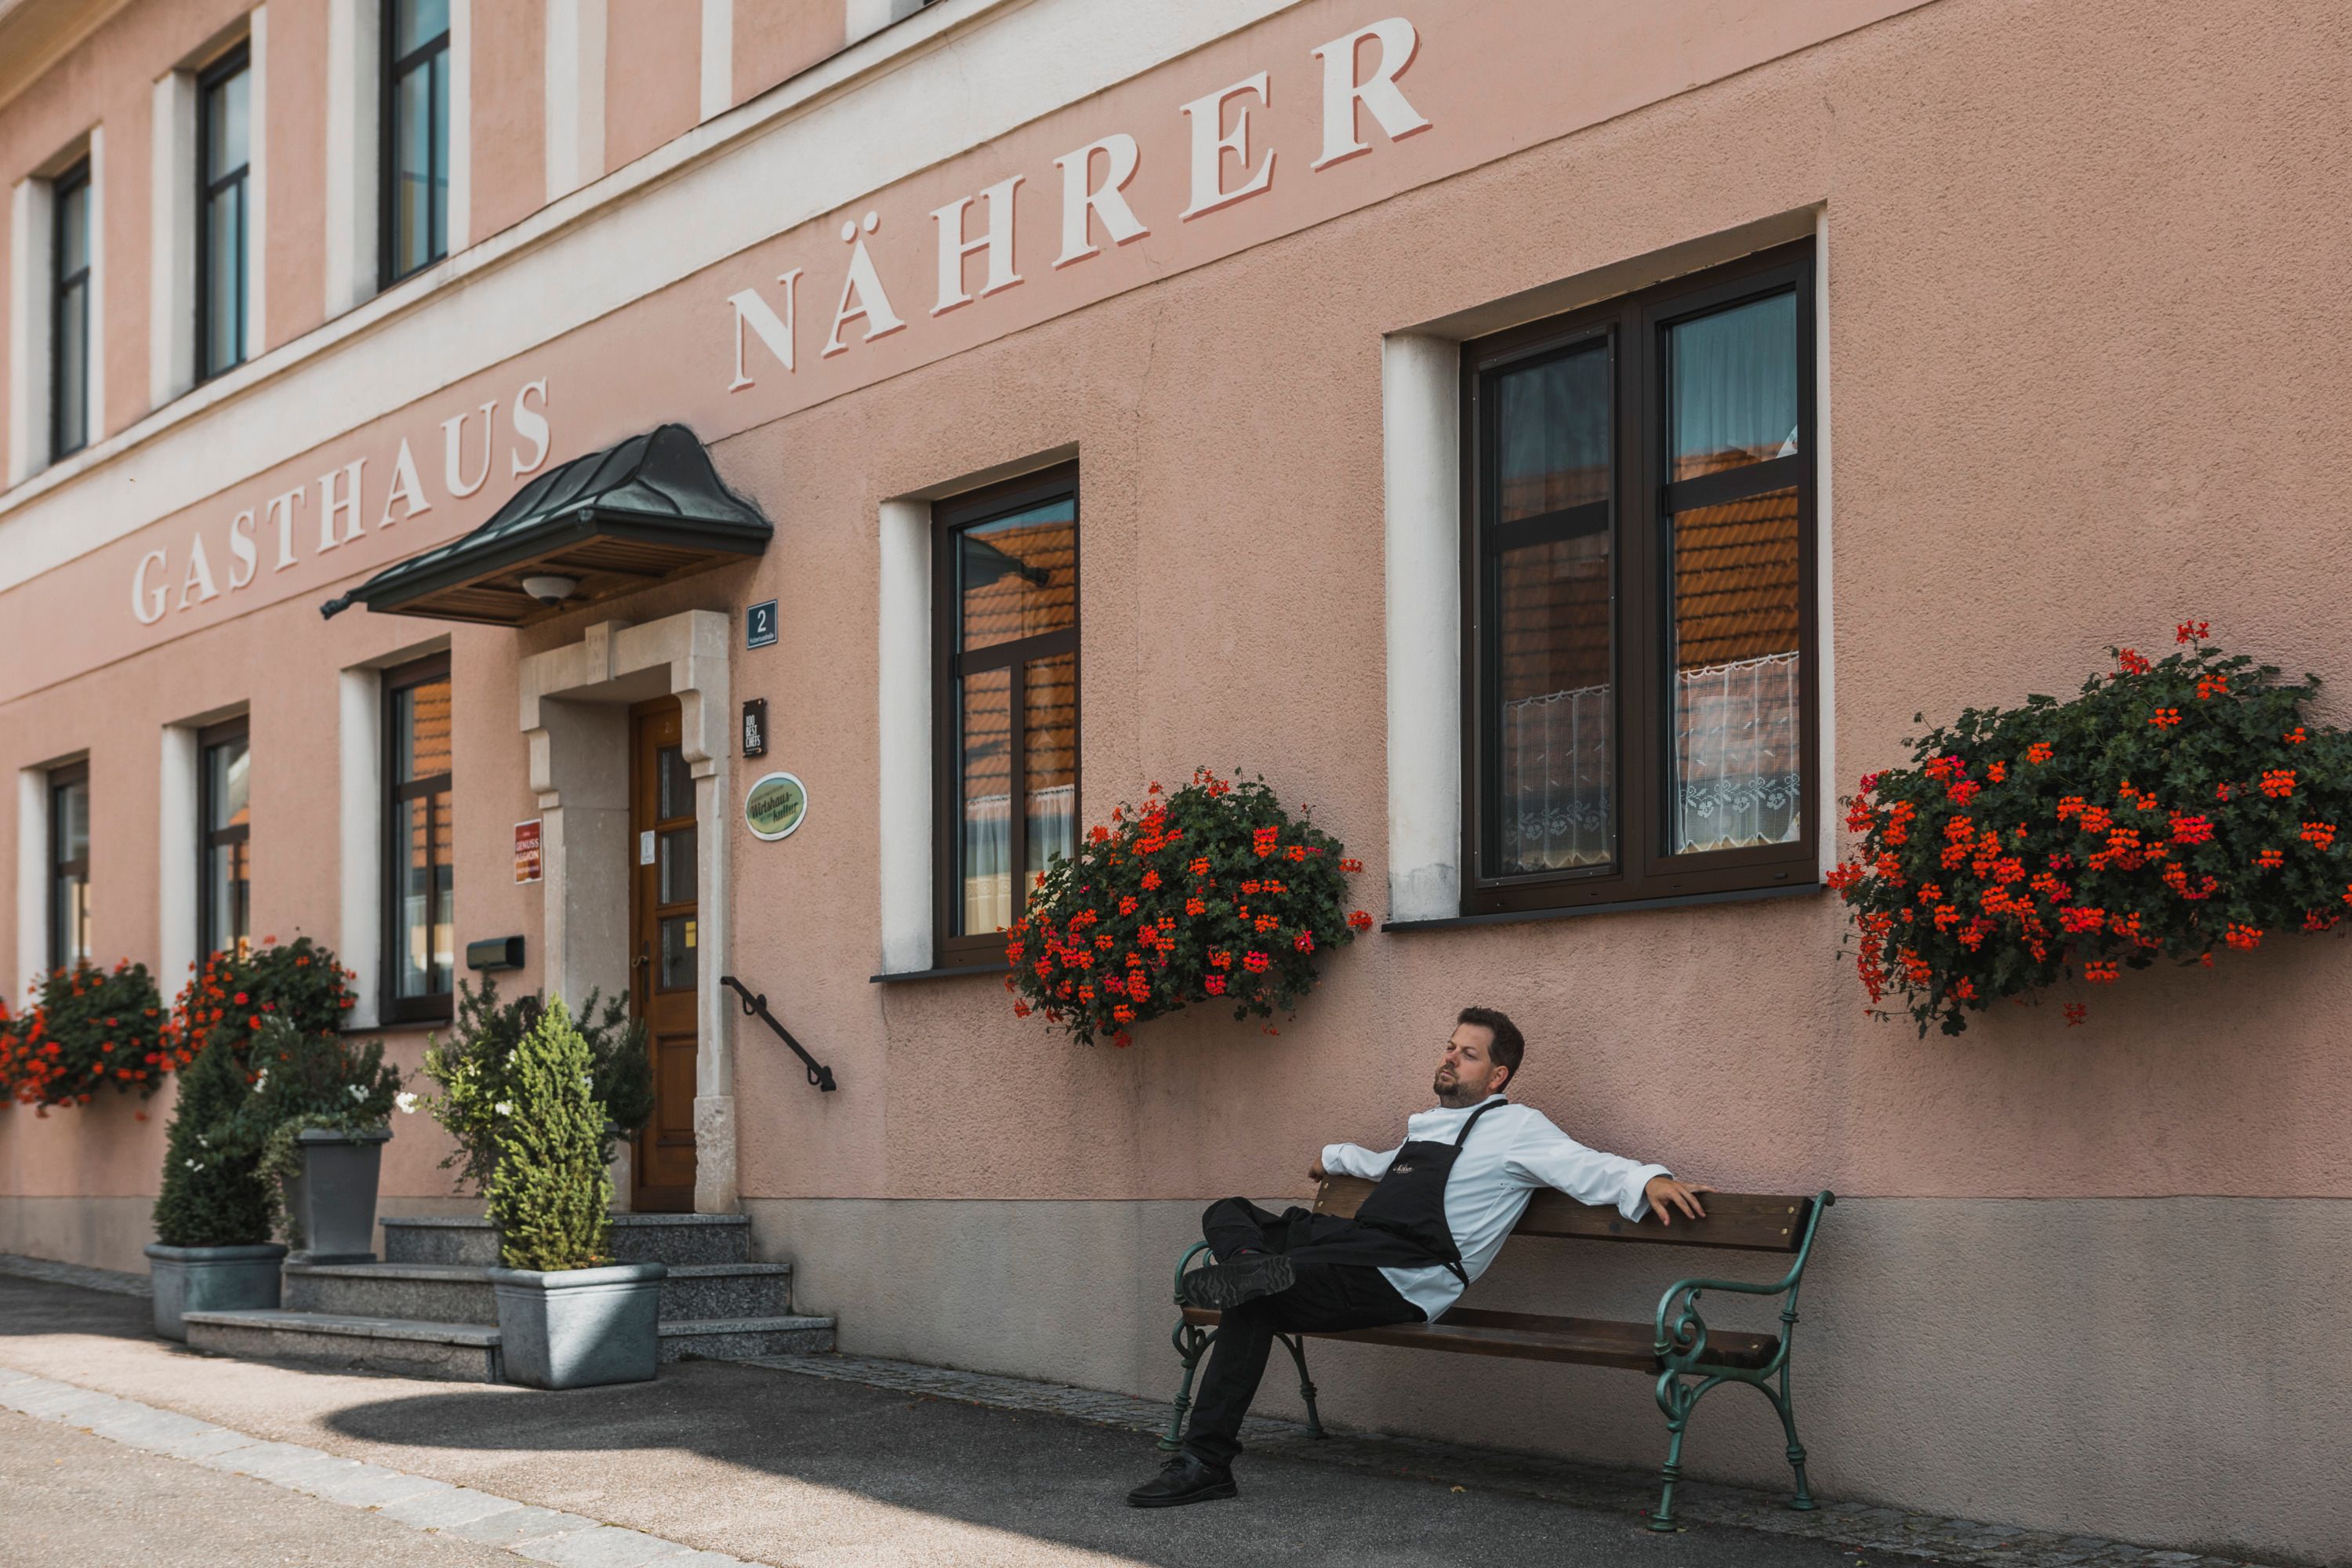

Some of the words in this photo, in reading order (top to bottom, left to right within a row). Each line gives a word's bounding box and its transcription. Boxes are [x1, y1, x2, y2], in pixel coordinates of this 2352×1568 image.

[132, 376, 550, 625] GASTHAUS
[728, 16, 1432, 392] NÄHRER
[757, 609, 767, 633] 2
[746, 724, 757, 737] BEST
[746, 735, 760, 748] CHEFS
[772, 802, 798, 823] kultur
[516, 838, 539, 851] GENUSS
